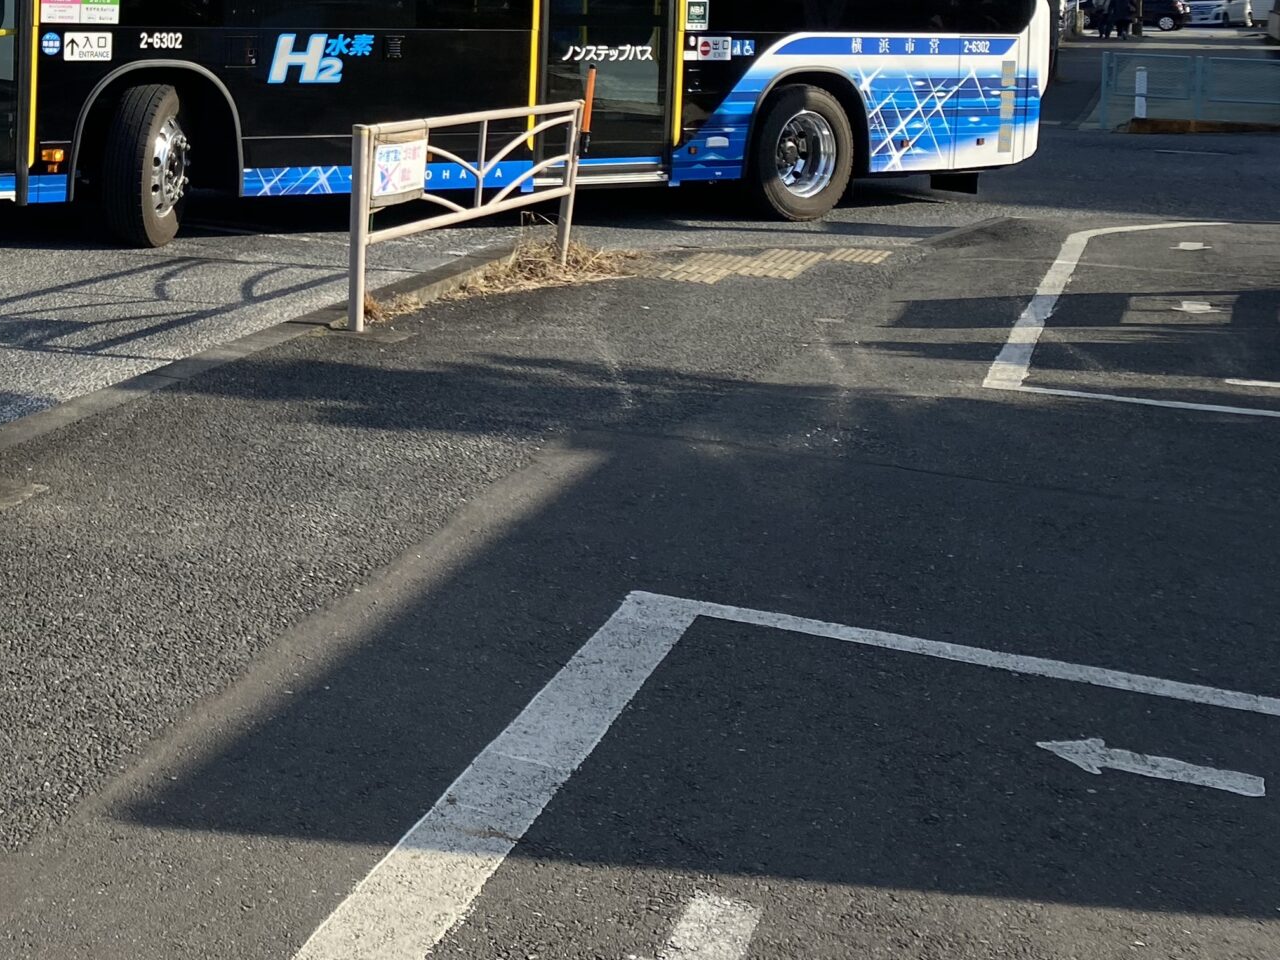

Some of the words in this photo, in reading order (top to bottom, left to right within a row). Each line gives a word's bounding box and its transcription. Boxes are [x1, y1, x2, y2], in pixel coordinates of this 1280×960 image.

[83, 36, 107, 48] 入口
[139, 32, 183, 49] 2-6302
[325, 33, 374, 55] 水素
[851, 37, 940, 54] 横浜市営
[963, 40, 990, 53] 2-6302
[79, 50, 110, 58] ENTRANCE
[267, 33, 343, 83] H2
[562, 43, 654, 61] ノンステップバス
